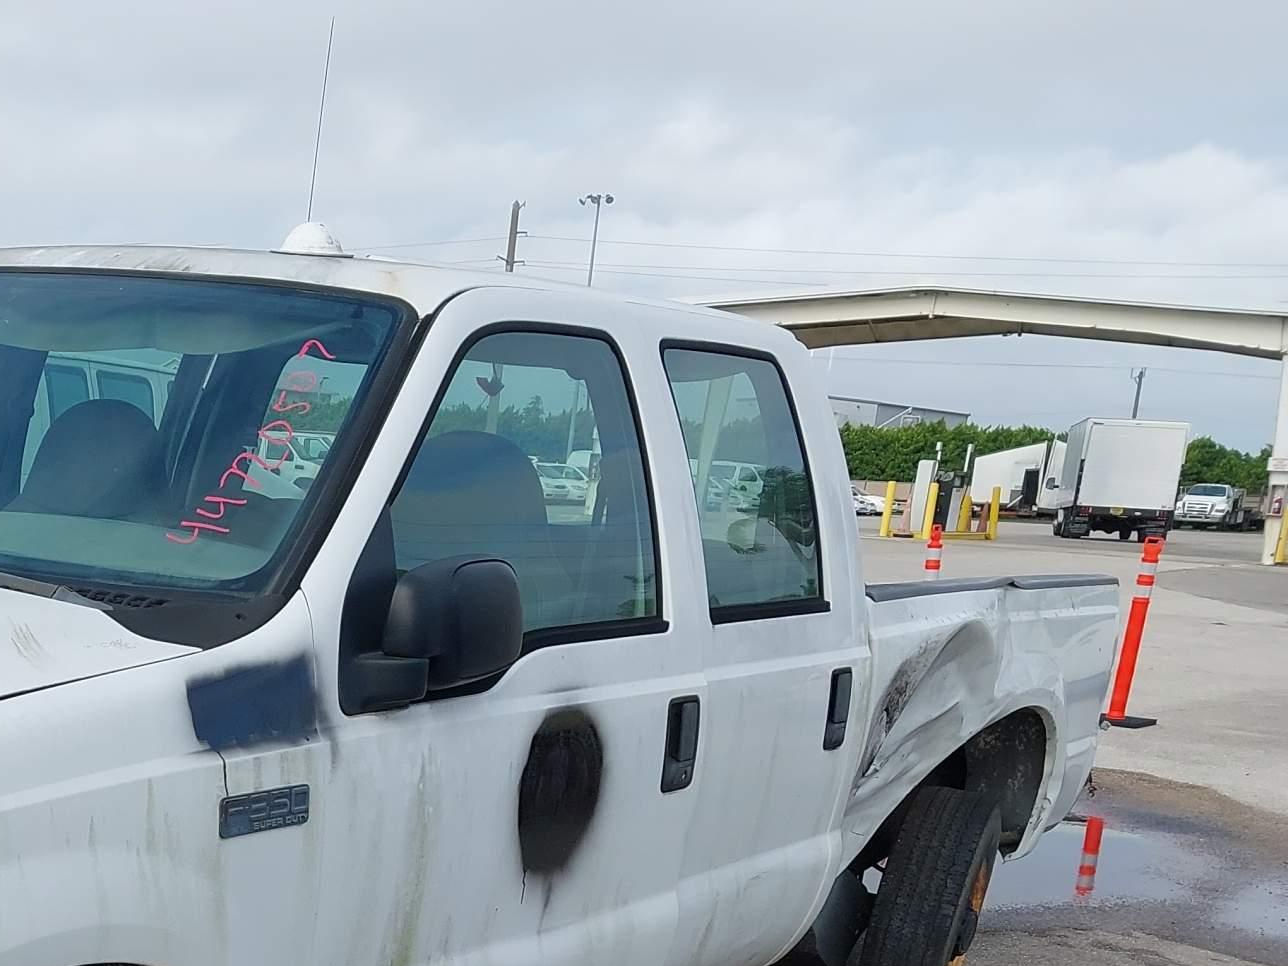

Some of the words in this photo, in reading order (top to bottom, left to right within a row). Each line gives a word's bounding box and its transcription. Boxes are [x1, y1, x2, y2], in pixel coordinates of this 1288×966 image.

[166, 339, 336, 544] 44720507
[253, 817, 284, 831] SUPER
[285, 813, 308, 825] DUTY
